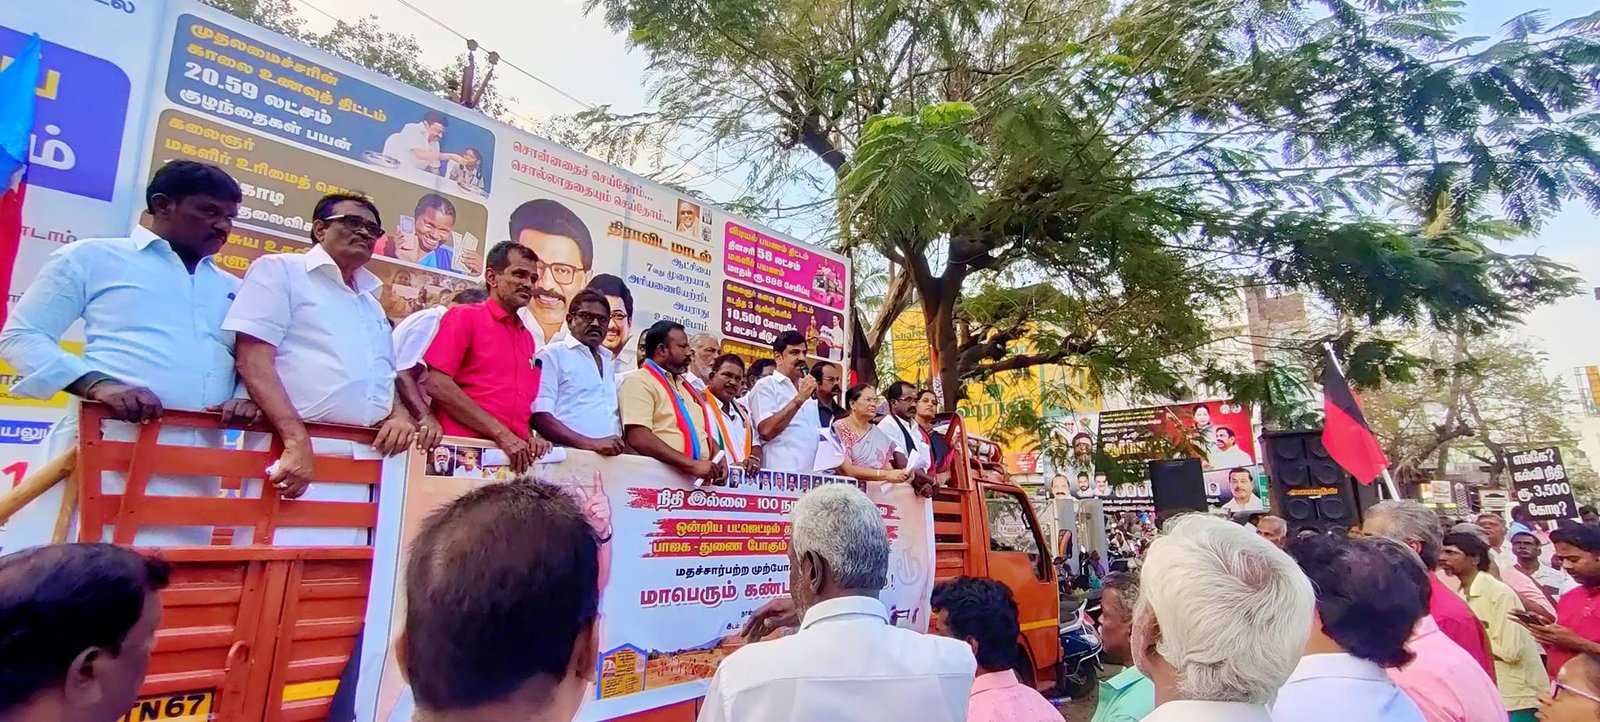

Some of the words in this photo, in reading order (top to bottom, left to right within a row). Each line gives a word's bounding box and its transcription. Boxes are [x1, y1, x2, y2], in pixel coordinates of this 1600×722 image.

[190, 23, 340, 87] முதலமைச்சரின்
[183, 61, 259, 100] 20.59
[264, 93, 333, 126] லட்சம்
[187, 42, 254, 75] காலை
[258, 68, 335, 106] உணவுத்
[338, 95, 388, 123] திட்டம்
[168, 117, 256, 151] கலைஞர்
[179, 88, 303, 136] குழந்தைகள்
[306, 130, 353, 152] பயன்
[164, 138, 232, 166] மகளிர்
[235, 157, 311, 192] உரிமைத்
[512, 141, 590, 177] சொன்னதைச்
[510, 159, 612, 203] சொல்லாததையும்
[607, 220, 669, 251] திராவிட
[671, 241, 713, 264] மாடல்
[756, 247, 773, 262] 58
[774, 256, 801, 272] லட்சம்
[725, 321, 732, 332] 3
[732, 324, 758, 339] லட்சம்
[1512, 448, 1555, 466] எங்கே?
[1513, 467, 1545, 482] கல்வி
[1544, 464, 1565, 482] நிதி
[655, 488, 685, 512] நிதி
[687, 488, 747, 509] இல்லை
[757, 497, 779, 509] 100
[1528, 500, 1568, 517] கோடி?
[675, 520, 723, 537] ஒன்றிய
[727, 521, 781, 537] பட்ஜெட்டில்
[652, 540, 692, 553] பாஜக
[699, 540, 744, 556] துணை
[747, 538, 788, 553] போகும்
[675, 563, 750, 579] மதச்சார்பற்ற
[751, 562, 792, 576] முற்போ
[639, 579, 738, 607] மாபெரும்
[744, 577, 791, 598] கண்ட
